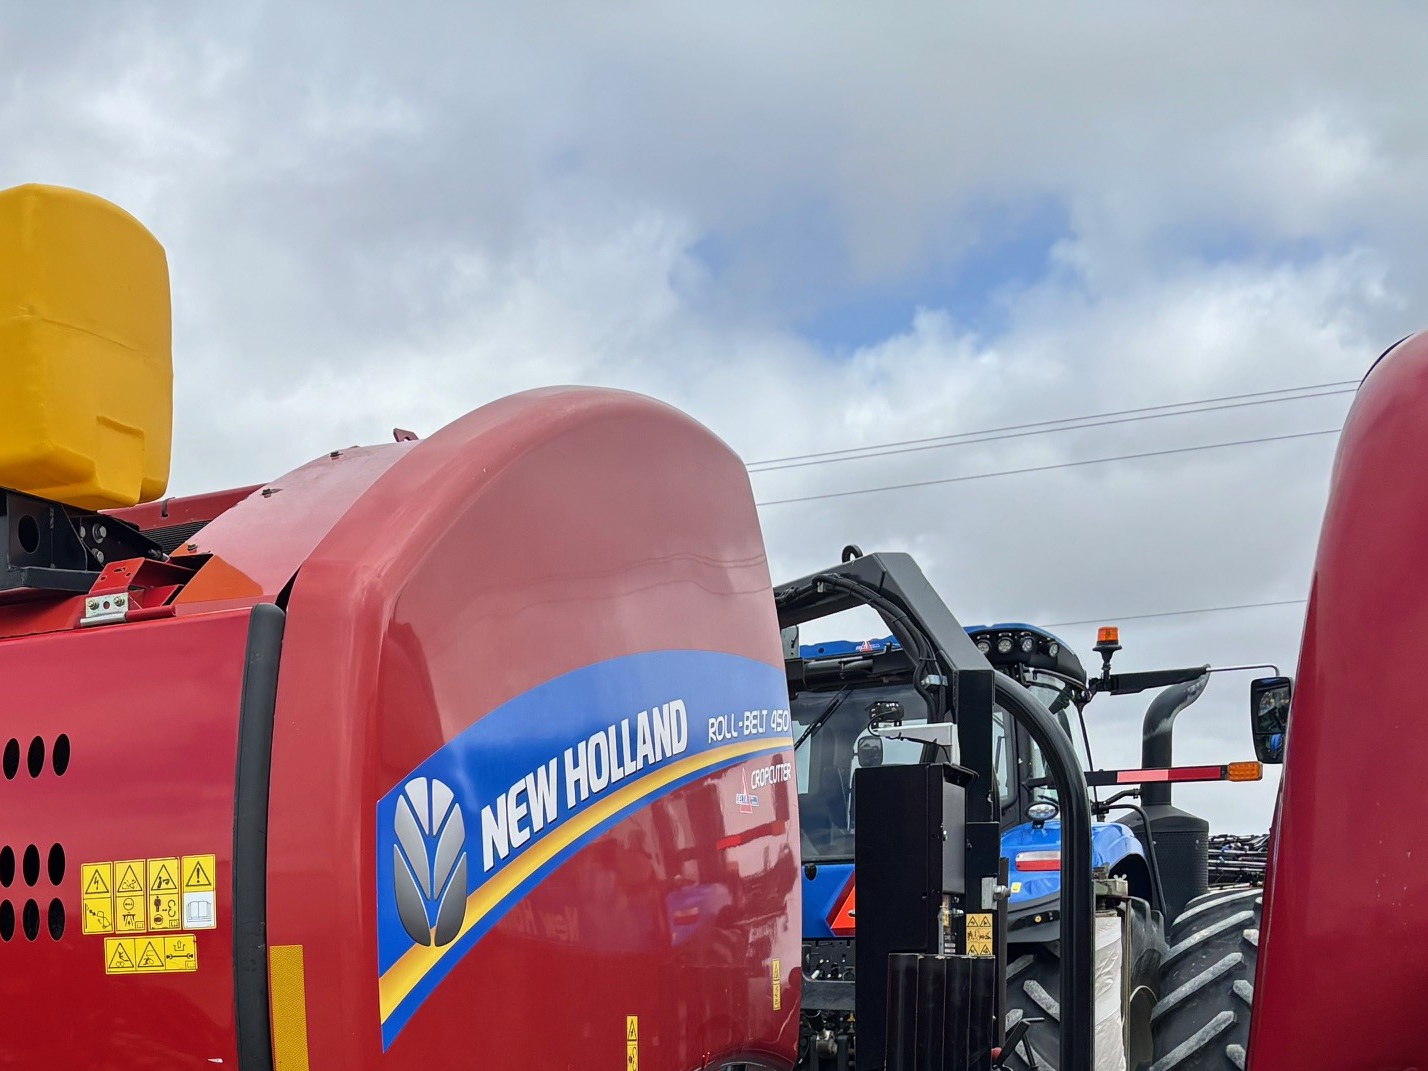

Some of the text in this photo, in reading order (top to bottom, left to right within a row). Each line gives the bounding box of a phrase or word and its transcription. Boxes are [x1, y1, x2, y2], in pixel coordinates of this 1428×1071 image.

[708, 709, 790, 744] ROLL-BELT 450
[481, 699, 688, 873] NEW HOLLAND
[751, 762, 792, 790] CROPCUTTER
